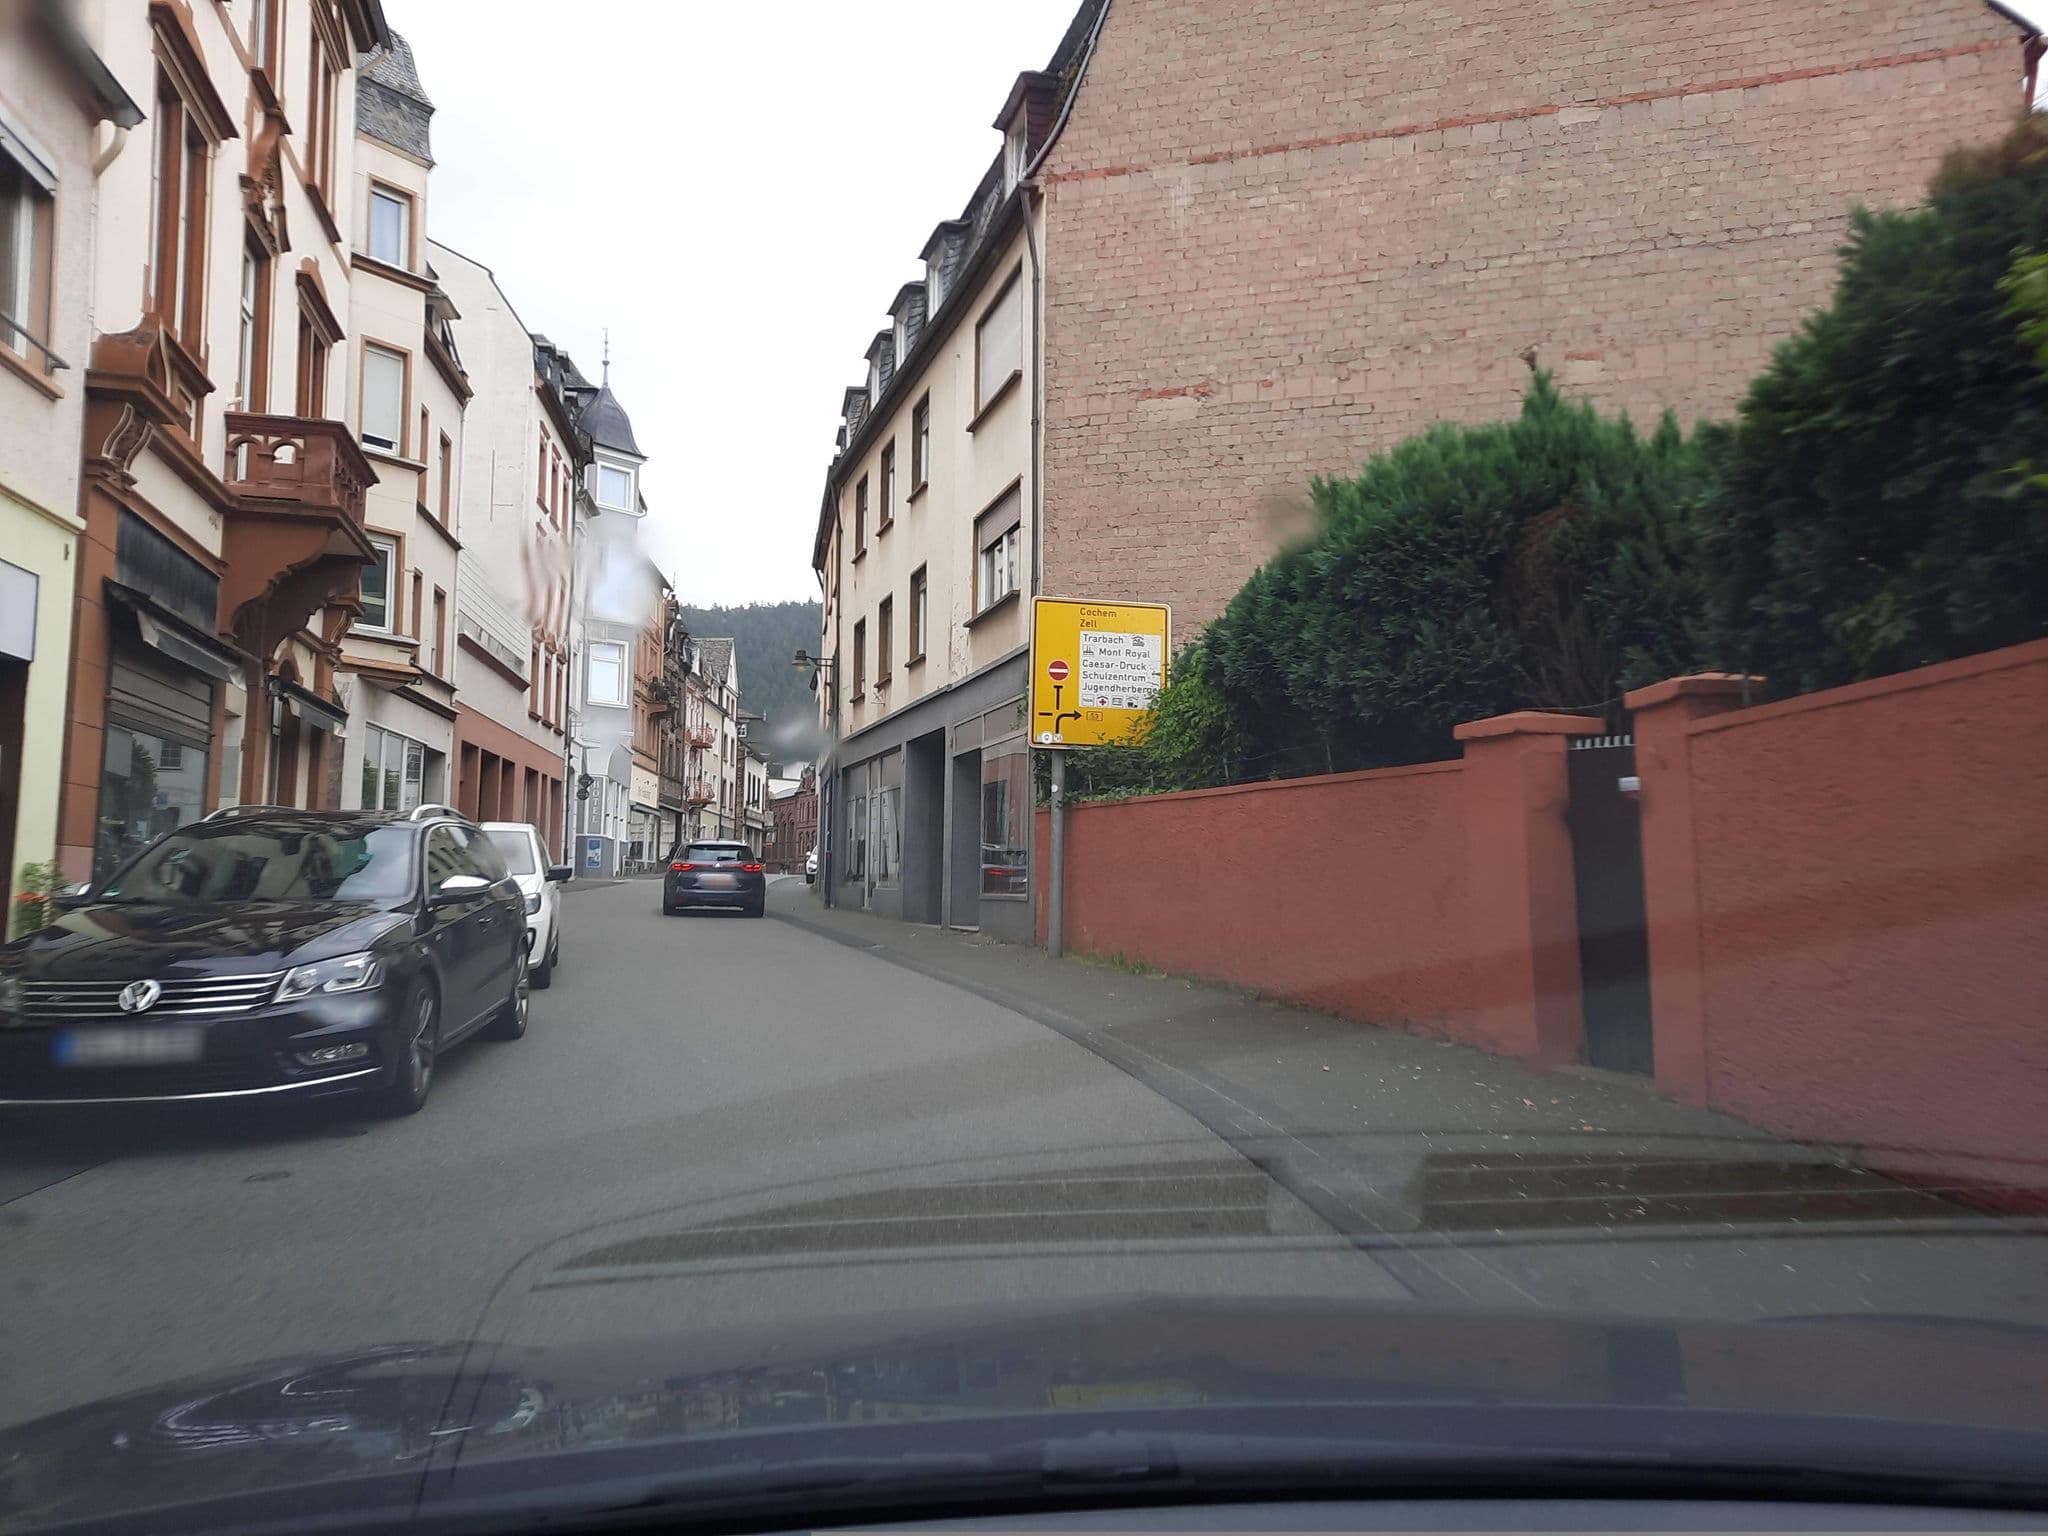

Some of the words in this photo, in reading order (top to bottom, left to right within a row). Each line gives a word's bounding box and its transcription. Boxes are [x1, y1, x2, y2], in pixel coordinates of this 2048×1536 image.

[1080, 608, 1117, 618] Cochem
[1080, 619, 1097, 628] Zell
[1083, 634, 1124, 644] Trarbach
[1099, 648, 1121, 657] Mont
[1125, 649, 1150, 660] Royal
[1082, 660, 1147, 671] Caesar-Druck
[1082, 671, 1146, 682] Schulzentrum
[1082, 683, 1158, 695] Jugendherberge
[592, 780, 601, 823] HOTEL
